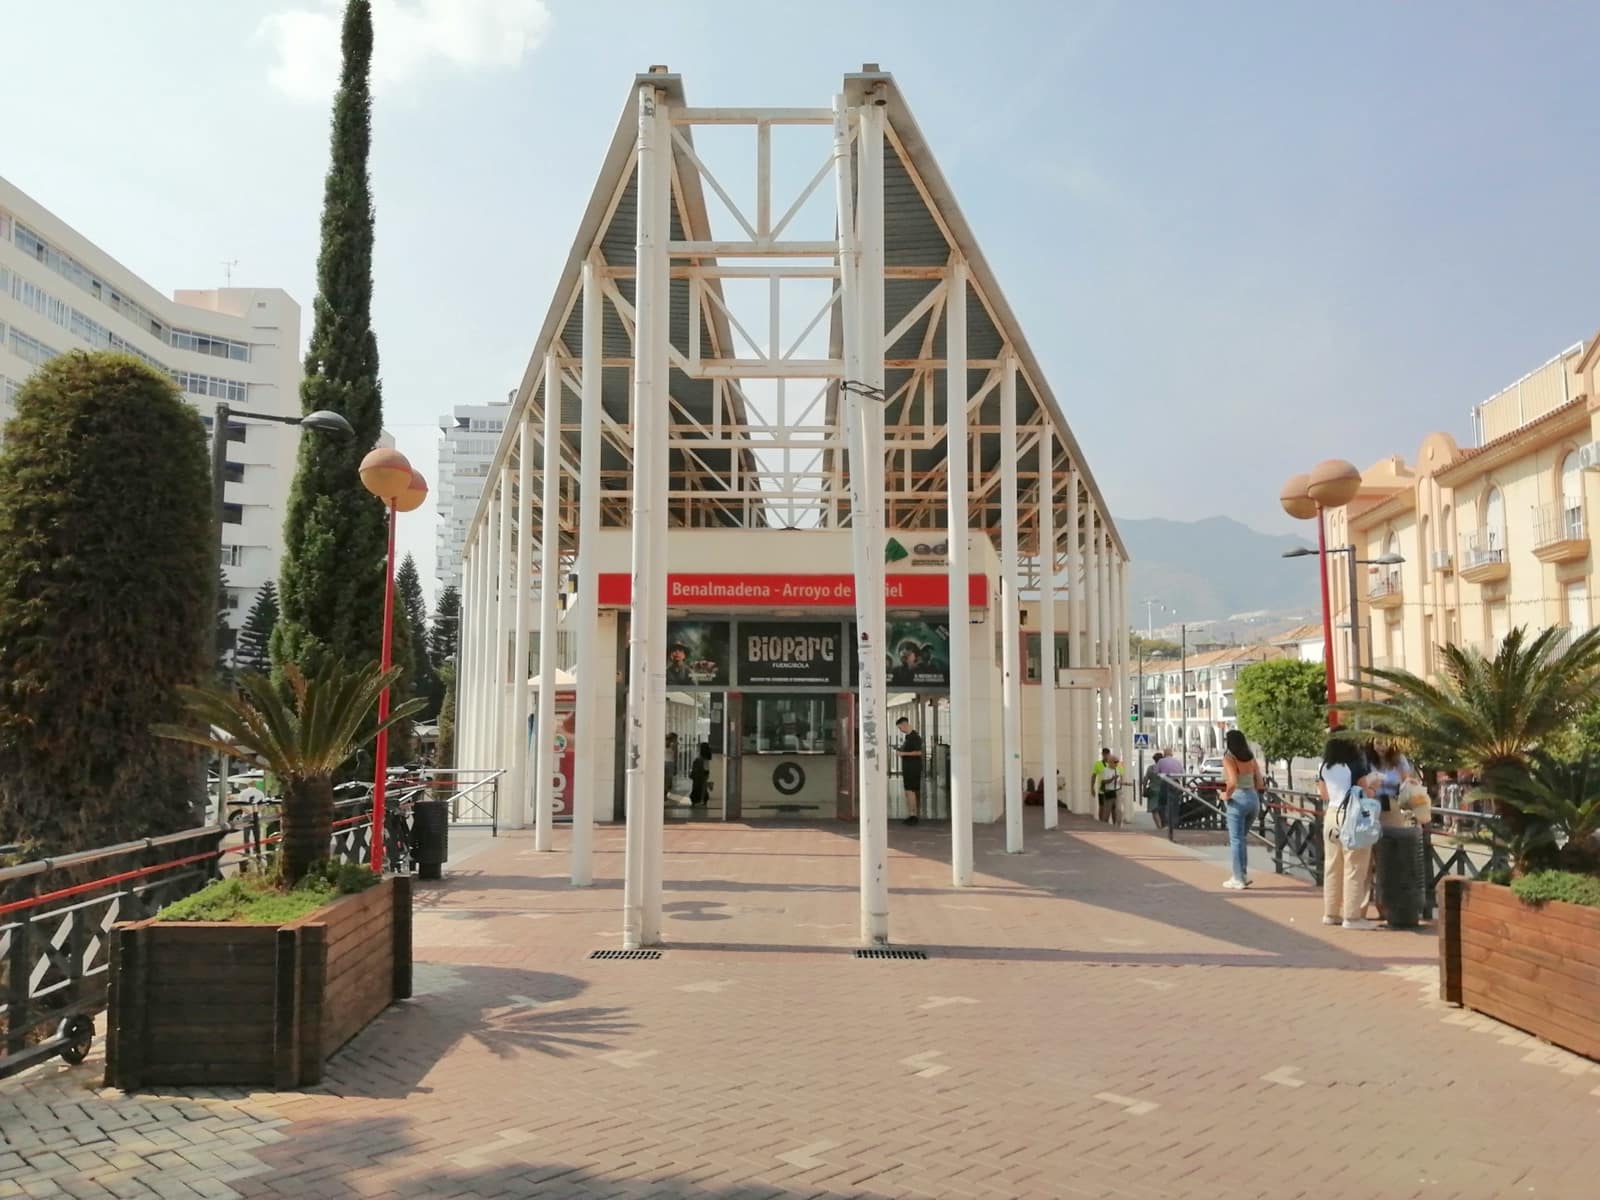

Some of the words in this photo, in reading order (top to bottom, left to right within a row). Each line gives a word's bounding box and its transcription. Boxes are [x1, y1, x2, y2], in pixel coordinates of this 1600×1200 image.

[672, 582, 770, 597] Benalmadena
[782, 583, 830, 601] Arroyo
[833, 581, 852, 597] de
